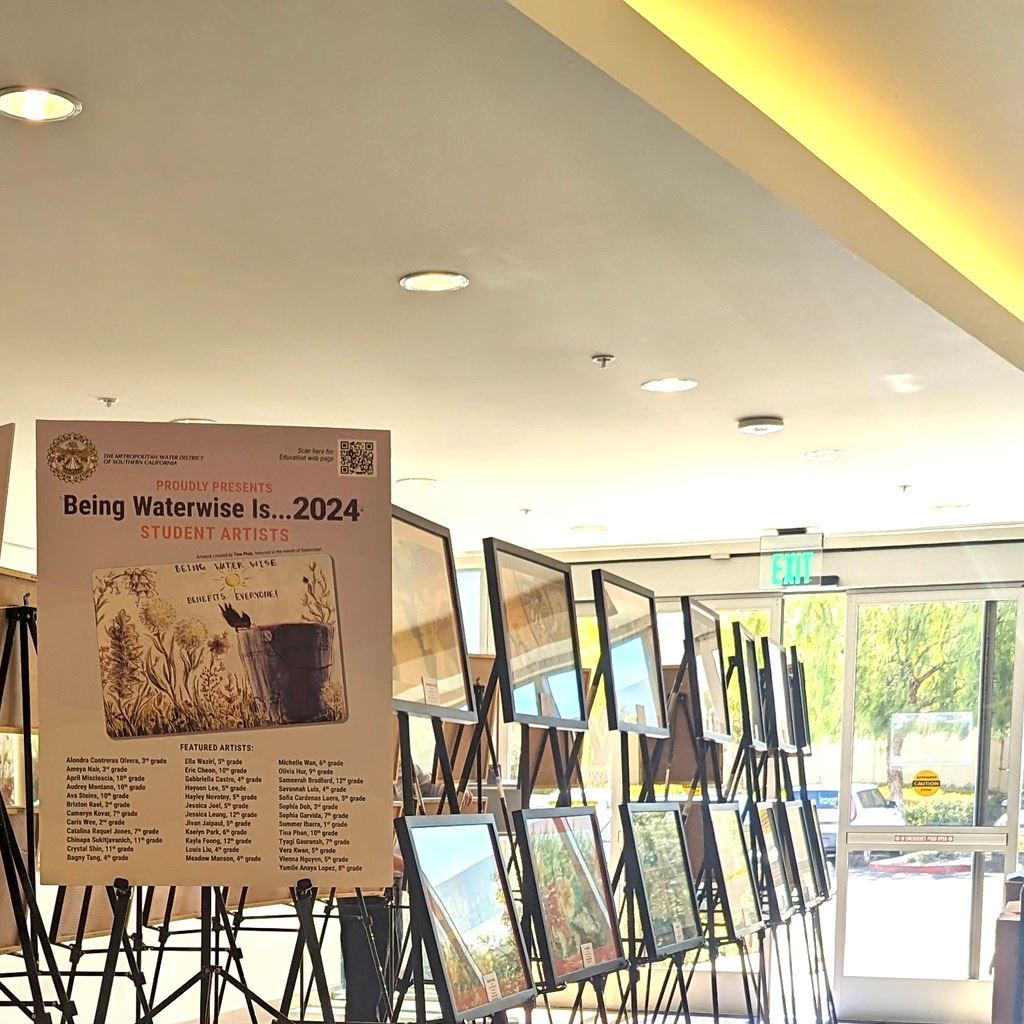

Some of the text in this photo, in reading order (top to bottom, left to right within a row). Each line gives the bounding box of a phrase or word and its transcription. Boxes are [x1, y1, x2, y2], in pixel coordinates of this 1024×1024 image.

[156, 480, 272, 492] PROUDLY PRESENTS
[63, 494, 360, 521] Being Waterwise Is...2024
[141, 525, 288, 541] STUDENT ARTISTS
[174, 559, 276, 572] BEING WATER WISE
[771, 552, 814, 585] EXIT
[186, 590, 277, 603] BENEFITS EVERYONE!
